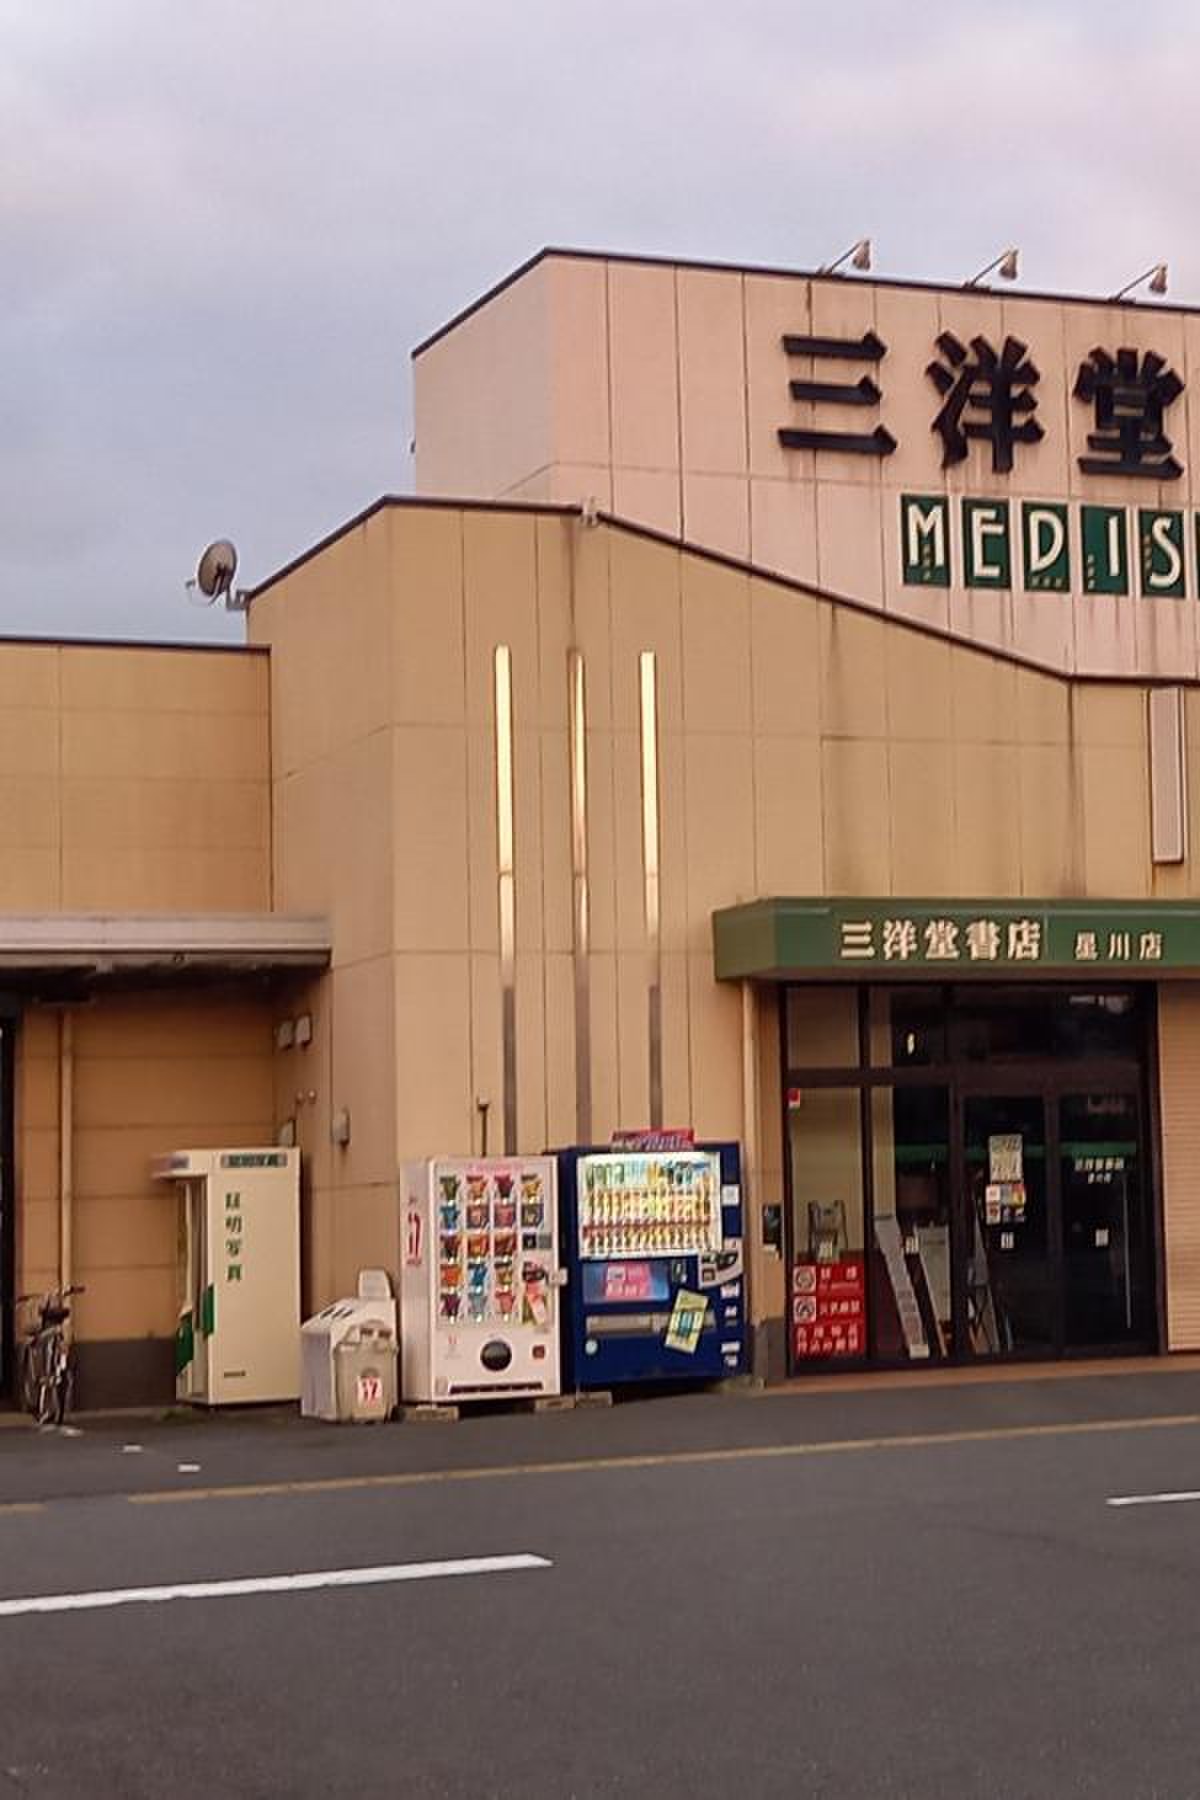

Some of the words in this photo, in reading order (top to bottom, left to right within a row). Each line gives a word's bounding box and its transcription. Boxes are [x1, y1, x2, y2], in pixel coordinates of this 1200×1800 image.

[841, 919, 1041, 961] 三洋堂書店
[1074, 932, 1162, 961] 星川店
